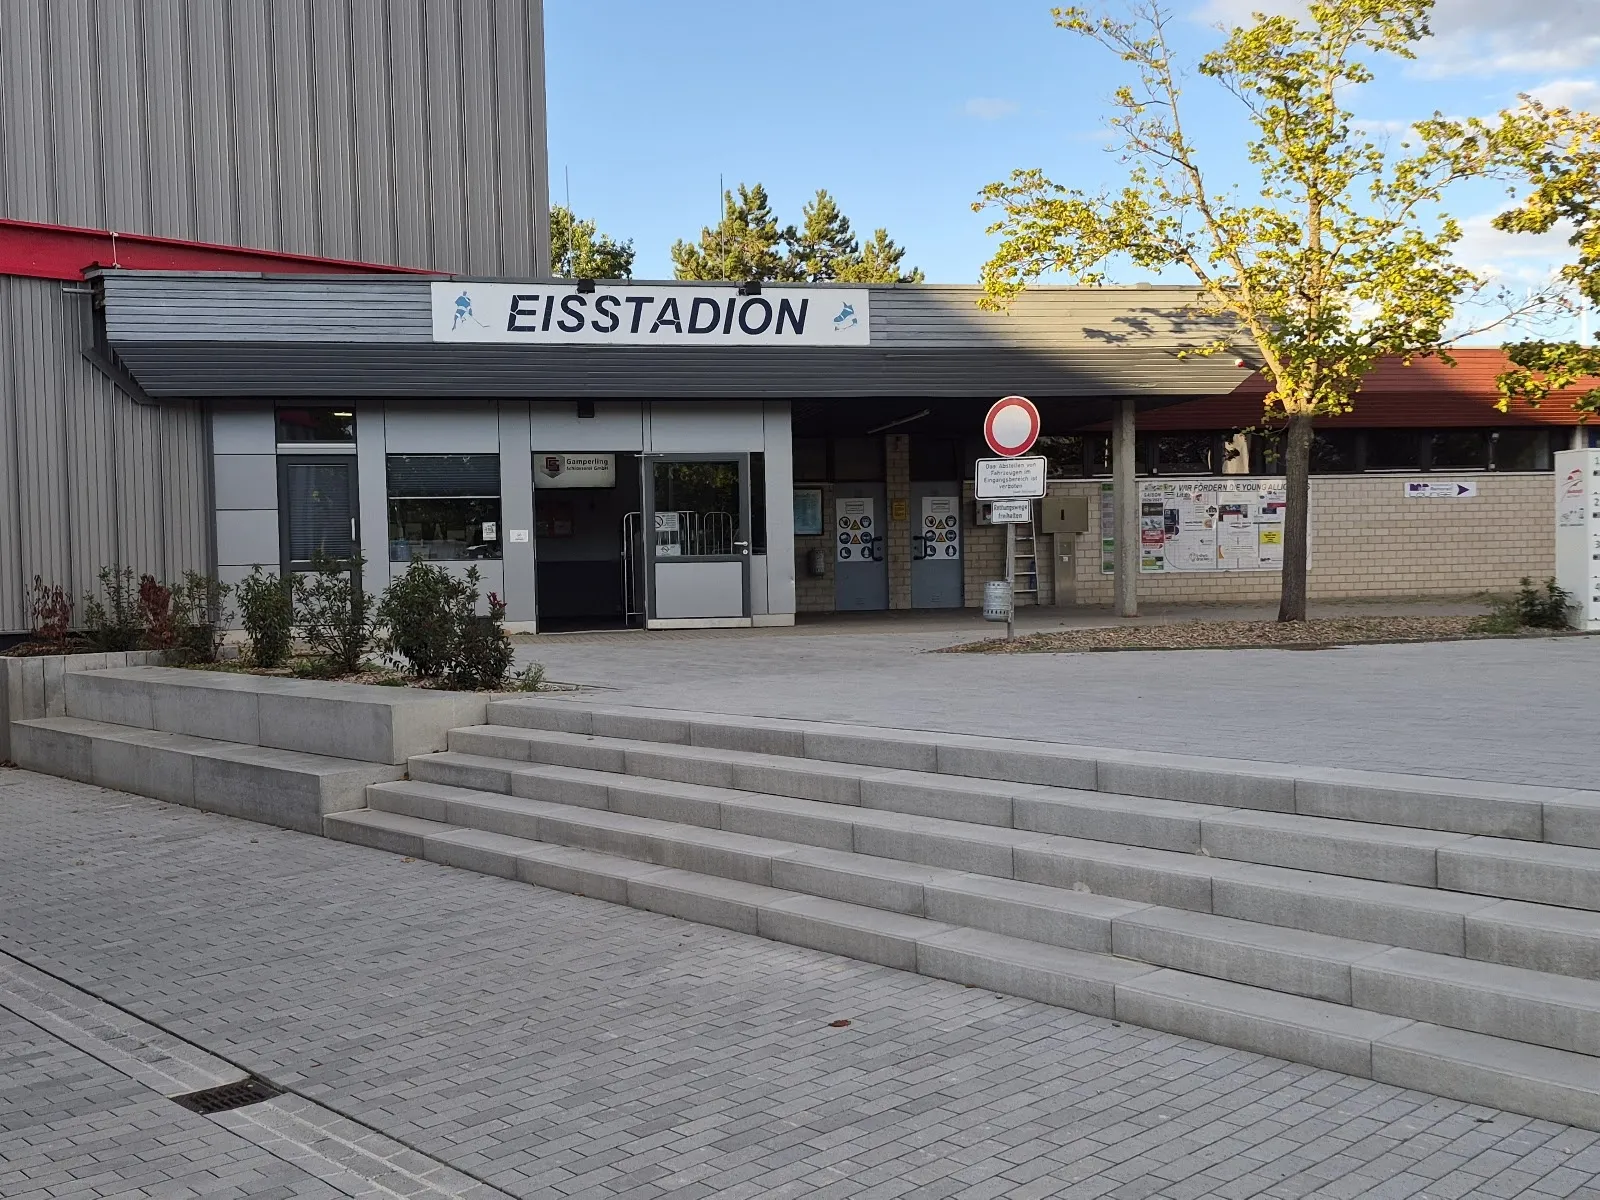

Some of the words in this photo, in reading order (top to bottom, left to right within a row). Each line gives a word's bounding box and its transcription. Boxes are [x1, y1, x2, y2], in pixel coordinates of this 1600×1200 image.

[507, 294, 809, 335] EISSTADION
[566, 458, 609, 466] Gamperling
[1193, 482, 1228, 491] FÖRDERN
[1242, 483, 1266, 491] YOUNG
[994, 504, 1028, 512] Rettungswege
